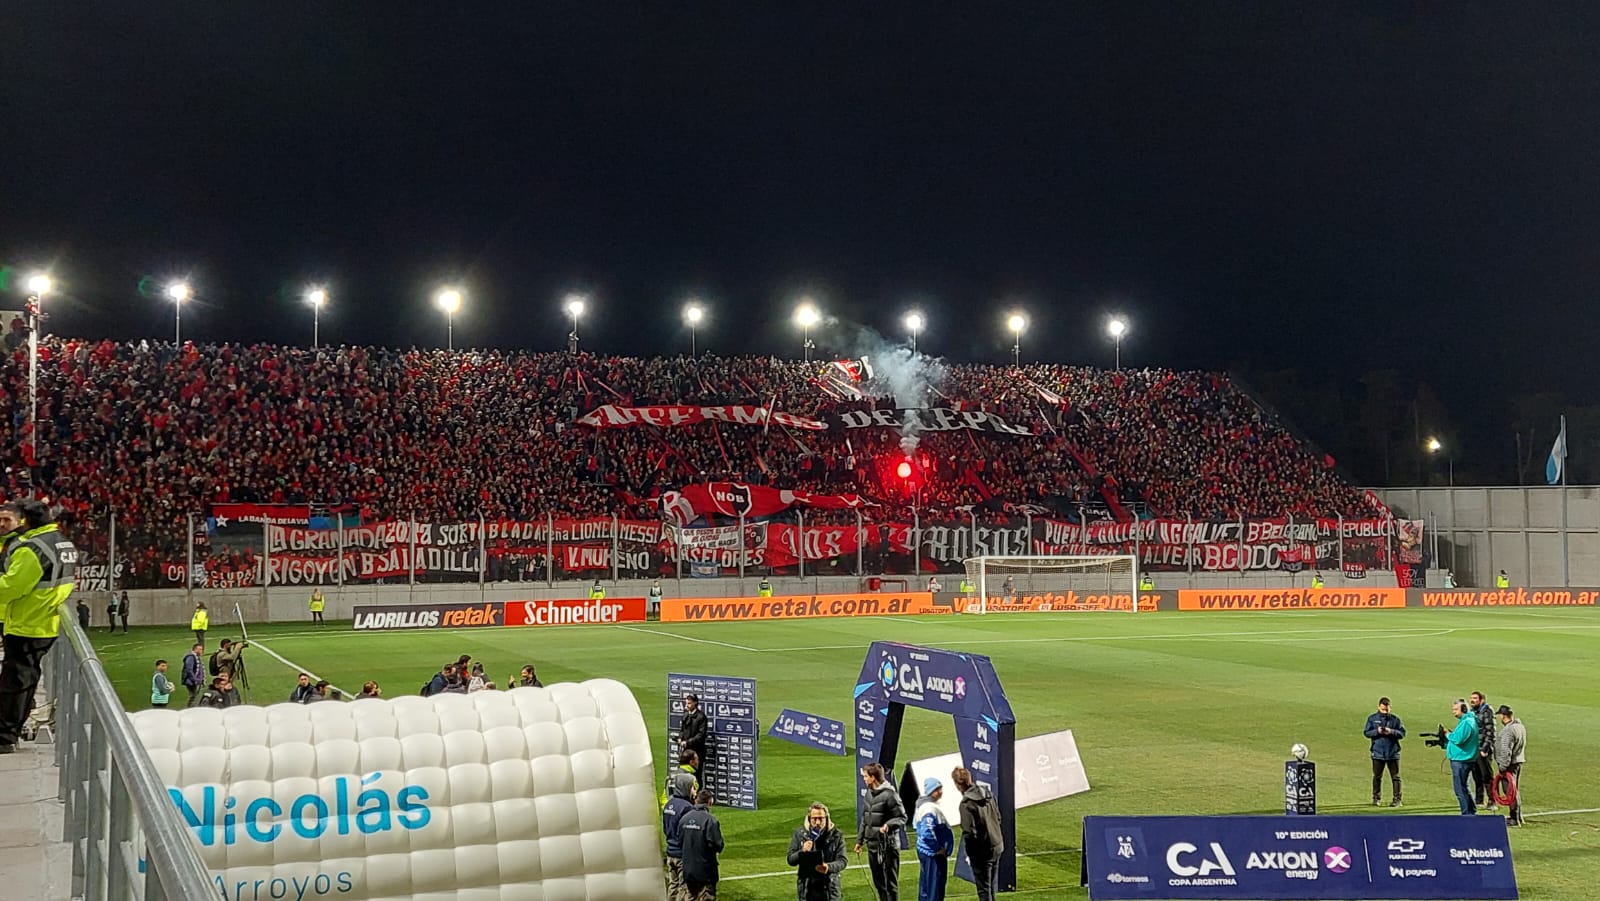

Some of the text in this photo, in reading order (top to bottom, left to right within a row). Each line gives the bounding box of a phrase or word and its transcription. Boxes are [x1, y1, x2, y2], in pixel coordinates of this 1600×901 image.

[571, 521, 616, 540] LIONEL
[619, 523, 659, 544] MESSI
[1143, 545, 1203, 566] ALVEAR
[1199, 590, 1388, 609] www.retak.com.ar
[1423, 588, 1599, 607] www.retak.com.ar
[354, 604, 498, 630] LADRILLOS retak
[524, 601, 623, 625] Schneider
[684, 597, 911, 620] www.retak.com.ar
[926, 676, 954, 694] AXION
[167, 771, 431, 846] Nicolás
[1290, 830, 1328, 840] EDICIÓN
[1166, 842, 1236, 877] CA
[1246, 852, 1318, 869] AXION
[1468, 848, 1504, 858] Nicolás
[1169, 878, 1237, 886] COPA ARGENTINA
[1286, 870, 1318, 880] energy
[1405, 868, 1437, 877] payway
